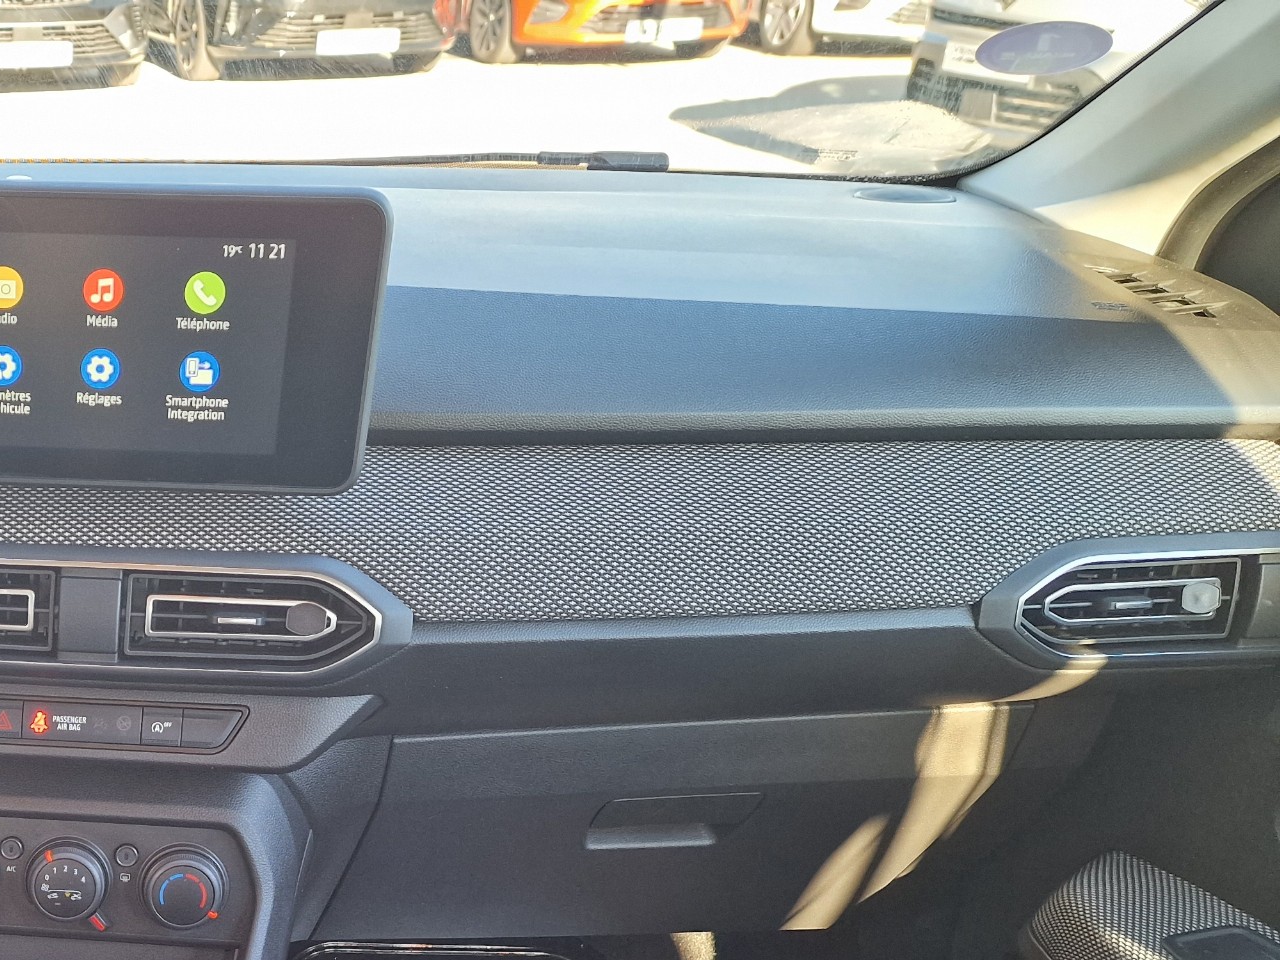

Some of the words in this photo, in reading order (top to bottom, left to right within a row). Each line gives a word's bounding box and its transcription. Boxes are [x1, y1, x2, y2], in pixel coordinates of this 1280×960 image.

[86, 314, 118, 327] Média
[175, 317, 230, 332] Téléphone
[76, 392, 122, 407] Réglages
[165, 395, 229, 409] Smartphone
[167, 408, 225, 422] Integration
[52, 715, 87, 724] PASSENGER
[56, 723, 68, 731] AIR
[68, 723, 81, 731] BAG
[6, 865, 17, 873] A/C
[63, 865, 68, 873] 2
